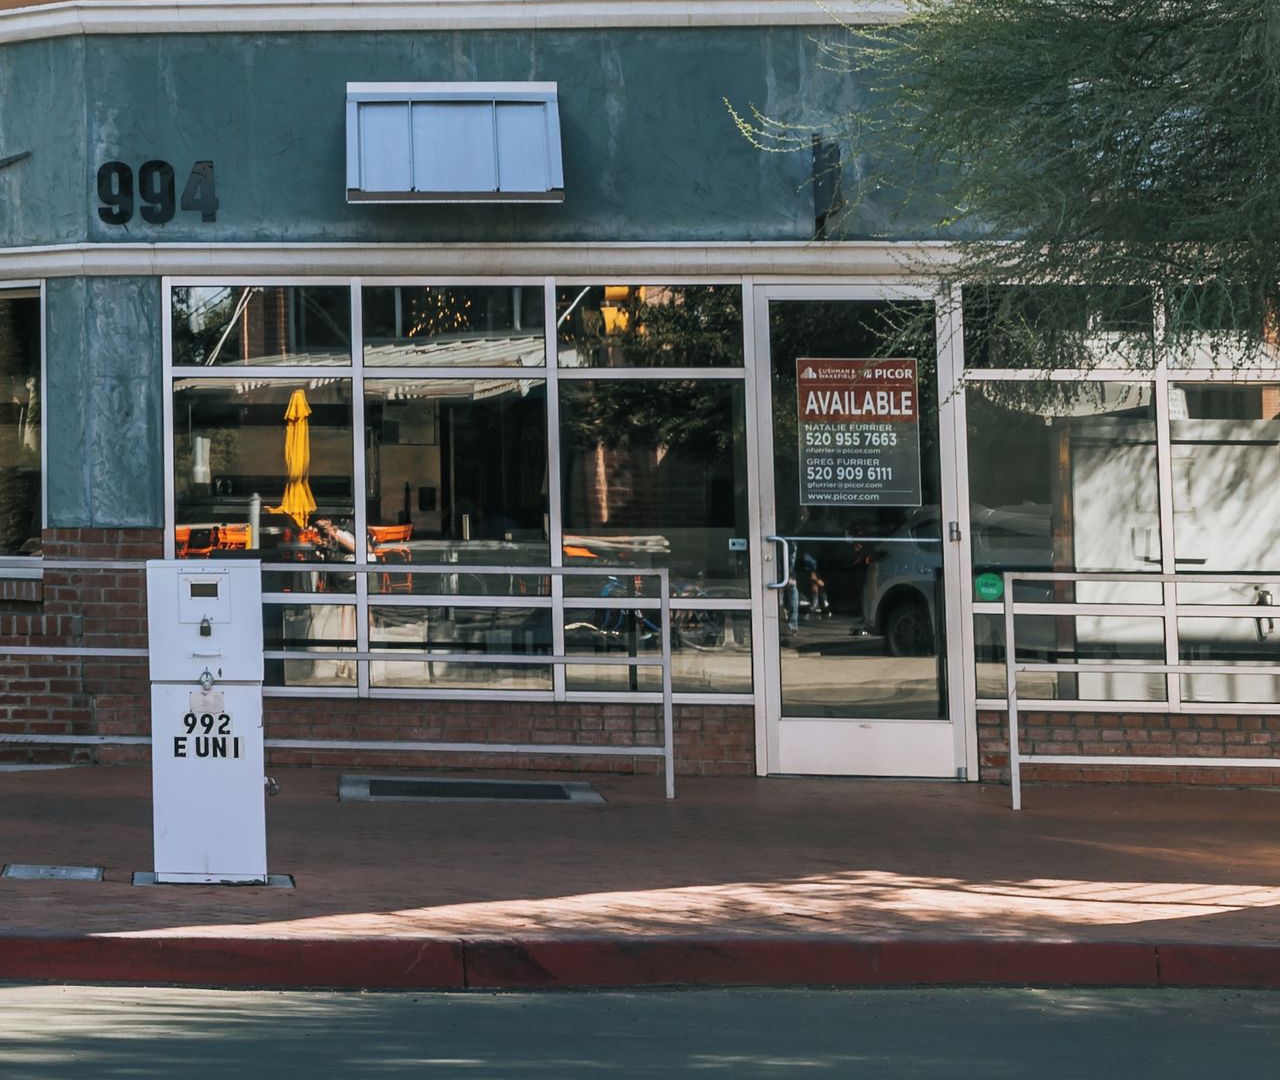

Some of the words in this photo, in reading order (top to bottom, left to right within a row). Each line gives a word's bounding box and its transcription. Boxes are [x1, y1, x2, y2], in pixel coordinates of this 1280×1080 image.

[97, 160, 219, 226] 994
[875, 368, 913, 379] PICOR
[805, 391, 913, 415] AVAILABLE
[806, 432, 832, 446] 520
[835, 432, 860, 446] 955
[864, 432, 897, 446] 7663
[806, 458, 834, 466] GREG
[837, 458, 880, 466] FURRIER
[807, 467, 832, 480] 520
[836, 467, 863, 480] 909
[867, 467, 893, 480] 6111
[807, 493, 880, 501] www.picor.com
[183, 713, 231, 735] 992
[174, 736, 187, 758] E
[195, 736, 240, 758] UNI
